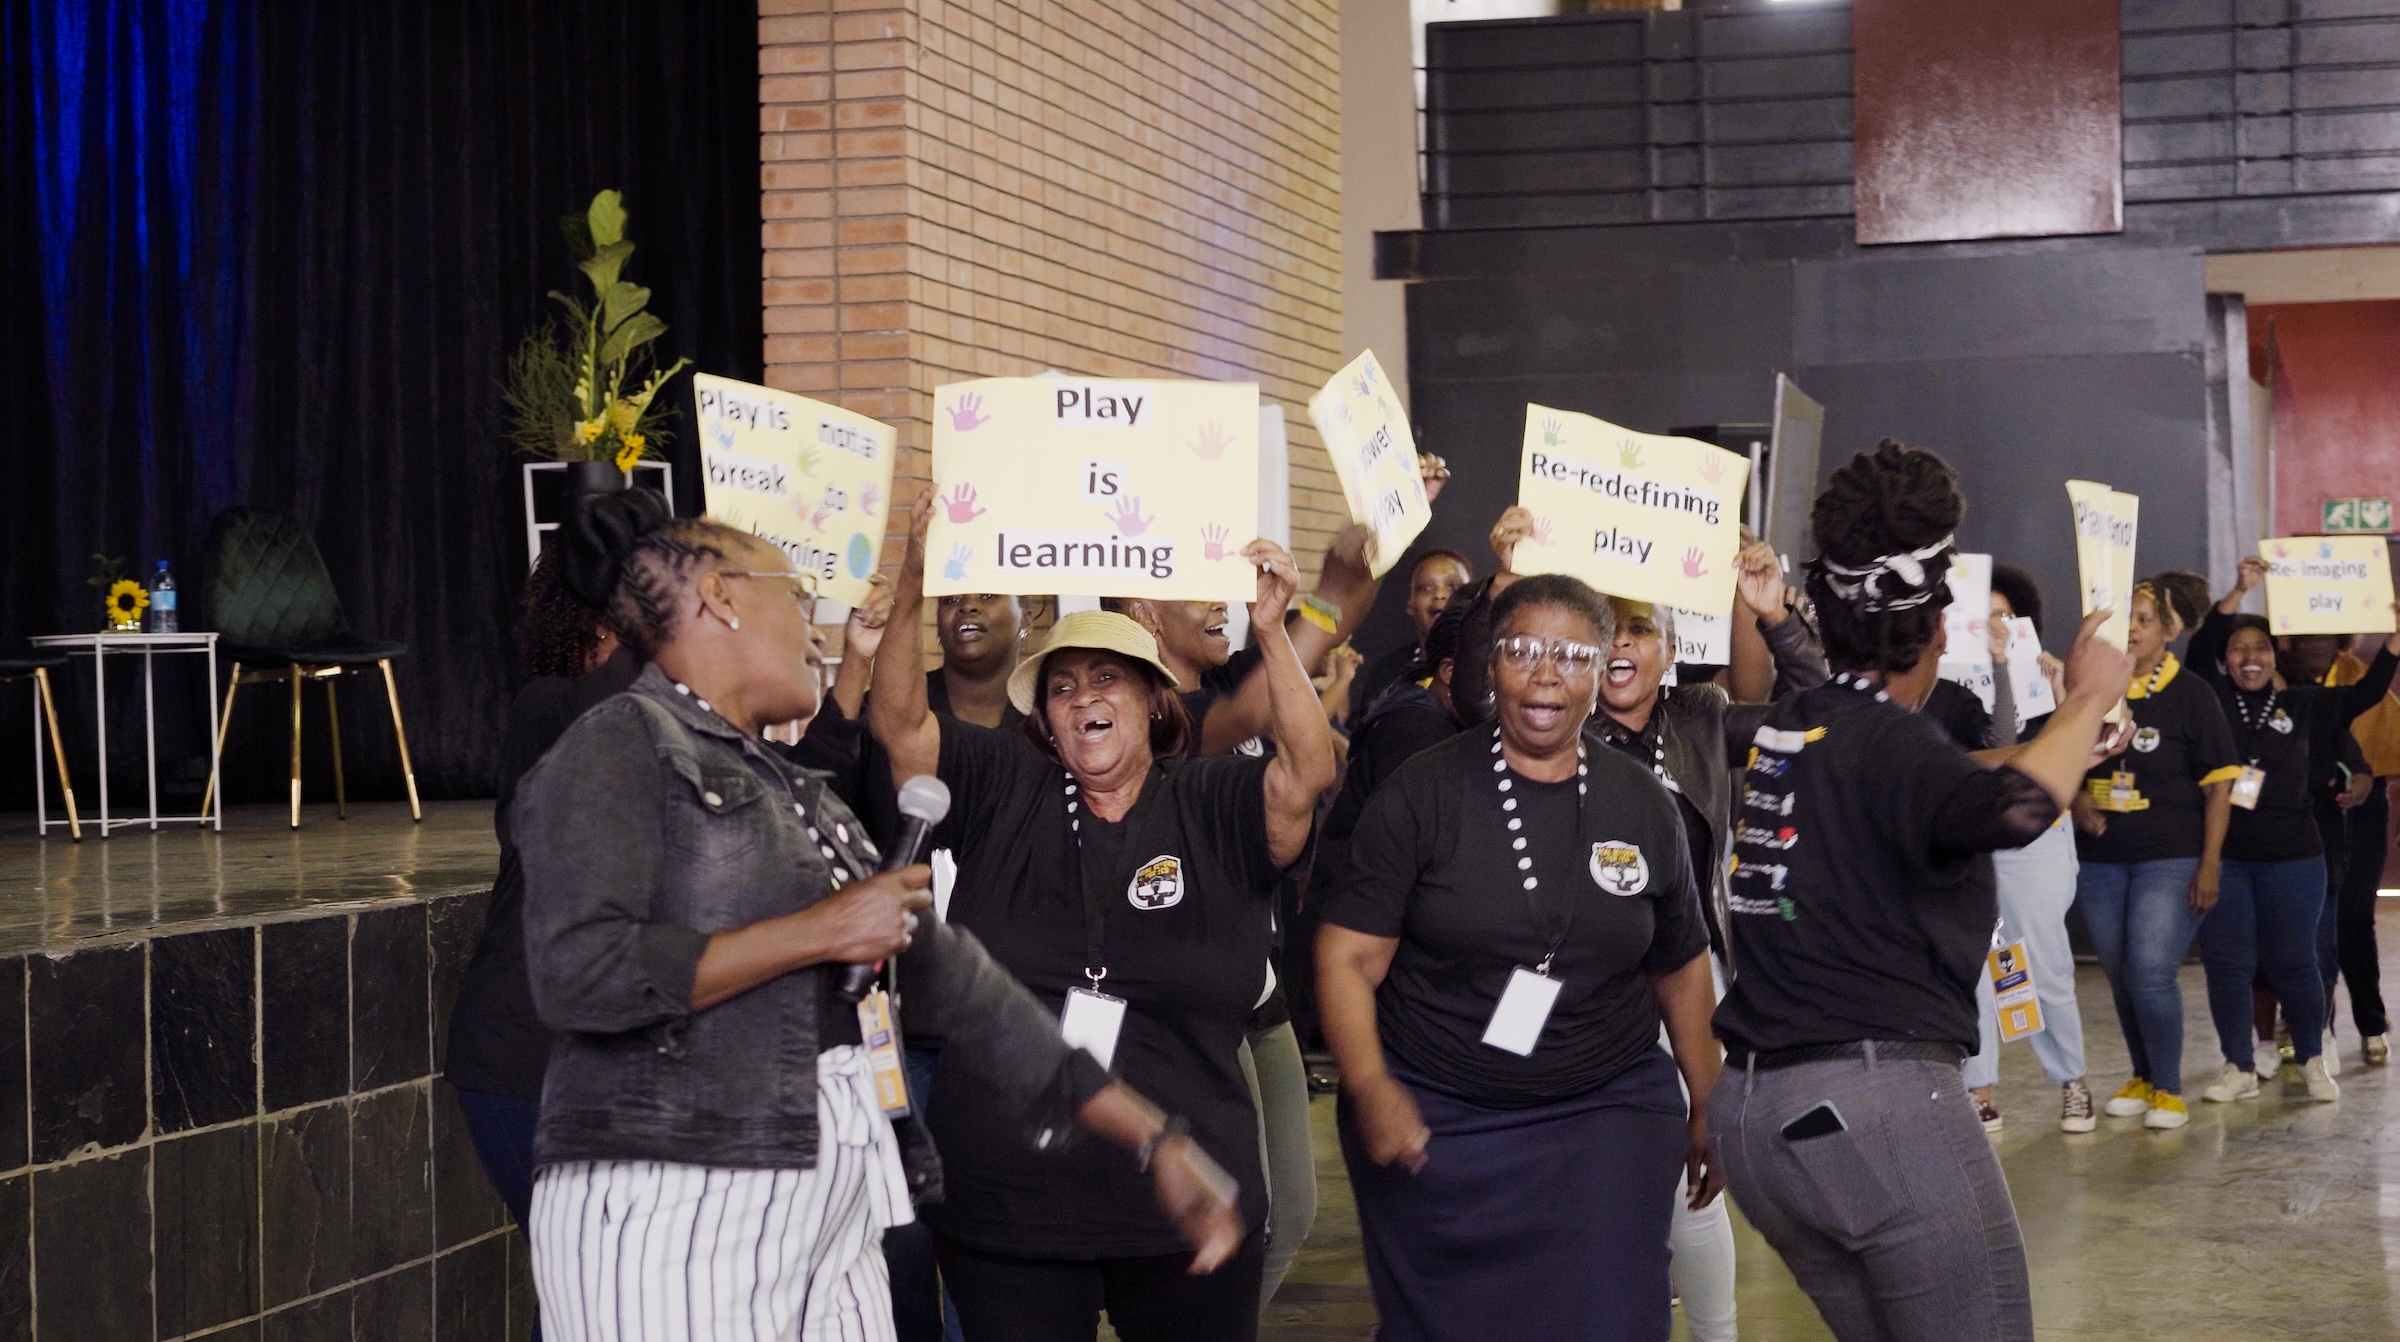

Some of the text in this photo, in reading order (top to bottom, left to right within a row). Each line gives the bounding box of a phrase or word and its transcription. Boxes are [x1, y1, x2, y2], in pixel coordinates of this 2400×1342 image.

[699, 388, 758, 431] Play
[767, 401, 789, 430] is
[1056, 387, 1144, 426] Play
[707, 454, 787, 496] break
[1088, 461, 1119, 496] is
[1531, 452, 1721, 525] Re-redefining
[997, 532, 1174, 579] learning
[1593, 525, 1654, 565] play
[2301, 561, 2368, 579] imaging
[2308, 593, 2344, 612] play
